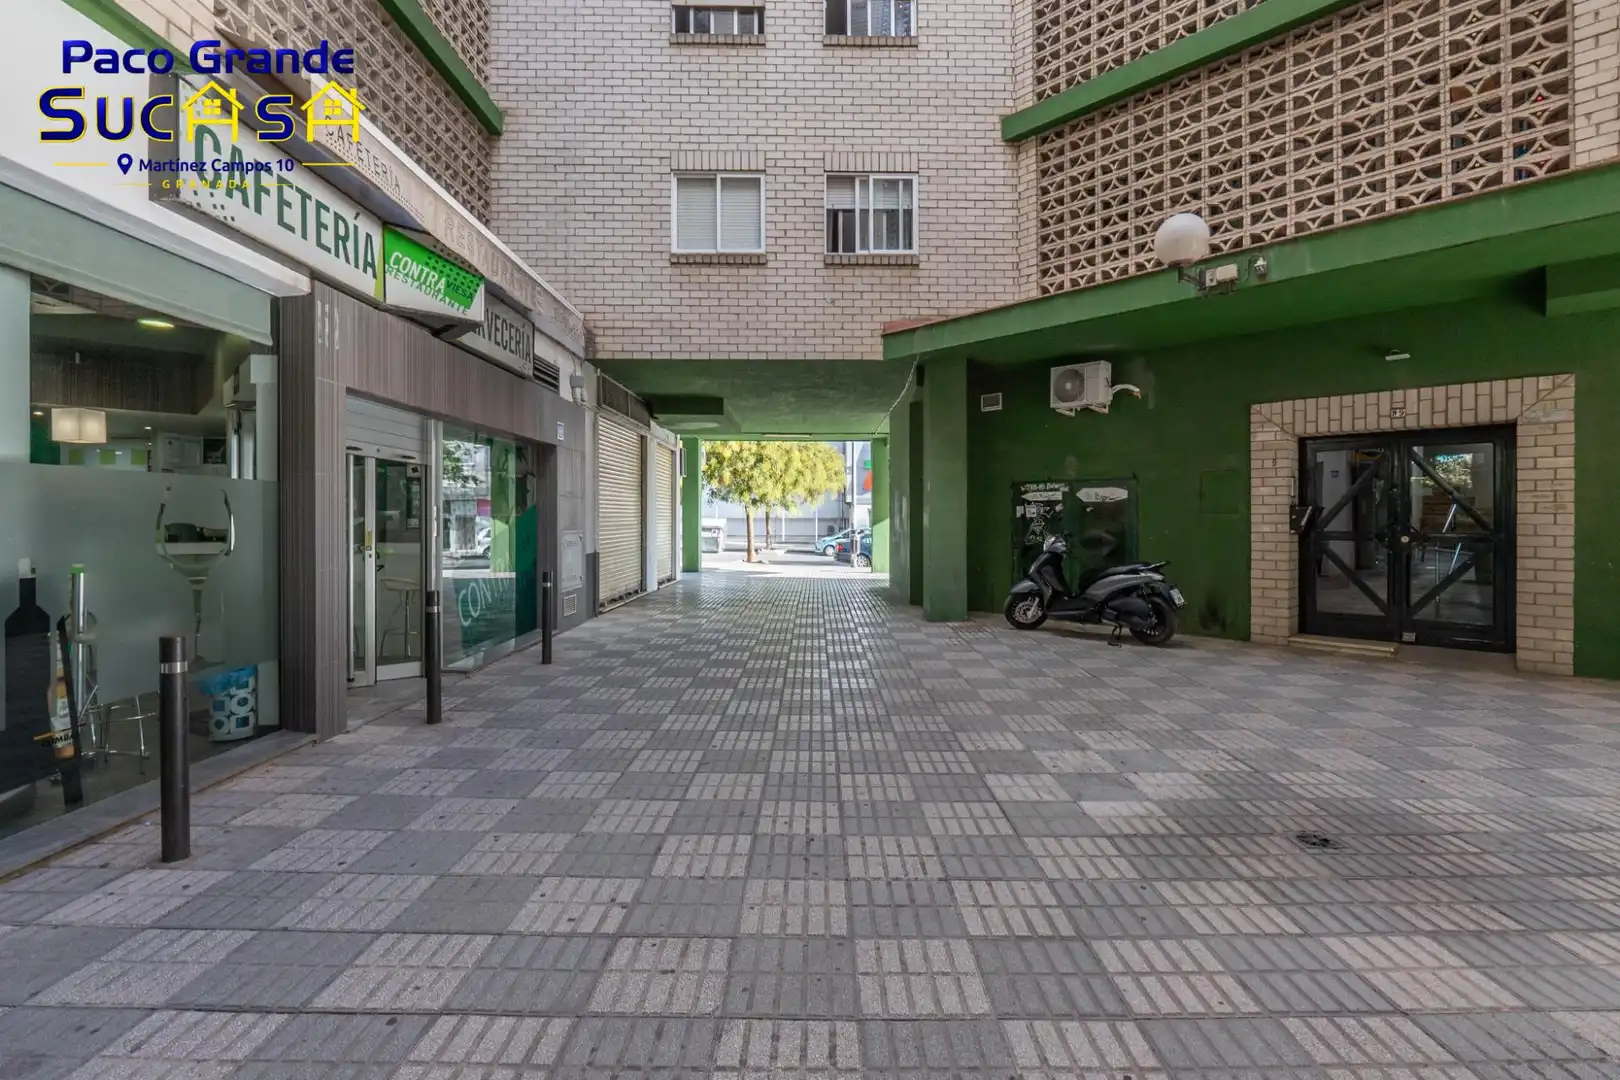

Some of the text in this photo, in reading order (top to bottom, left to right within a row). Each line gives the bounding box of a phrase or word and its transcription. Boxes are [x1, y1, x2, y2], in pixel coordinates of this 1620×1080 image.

[194, 124, 377, 280] CAFETERÍA
[385, 264, 469, 316] RESTAURANTE
[475, 308, 532, 364] VECERÍA
